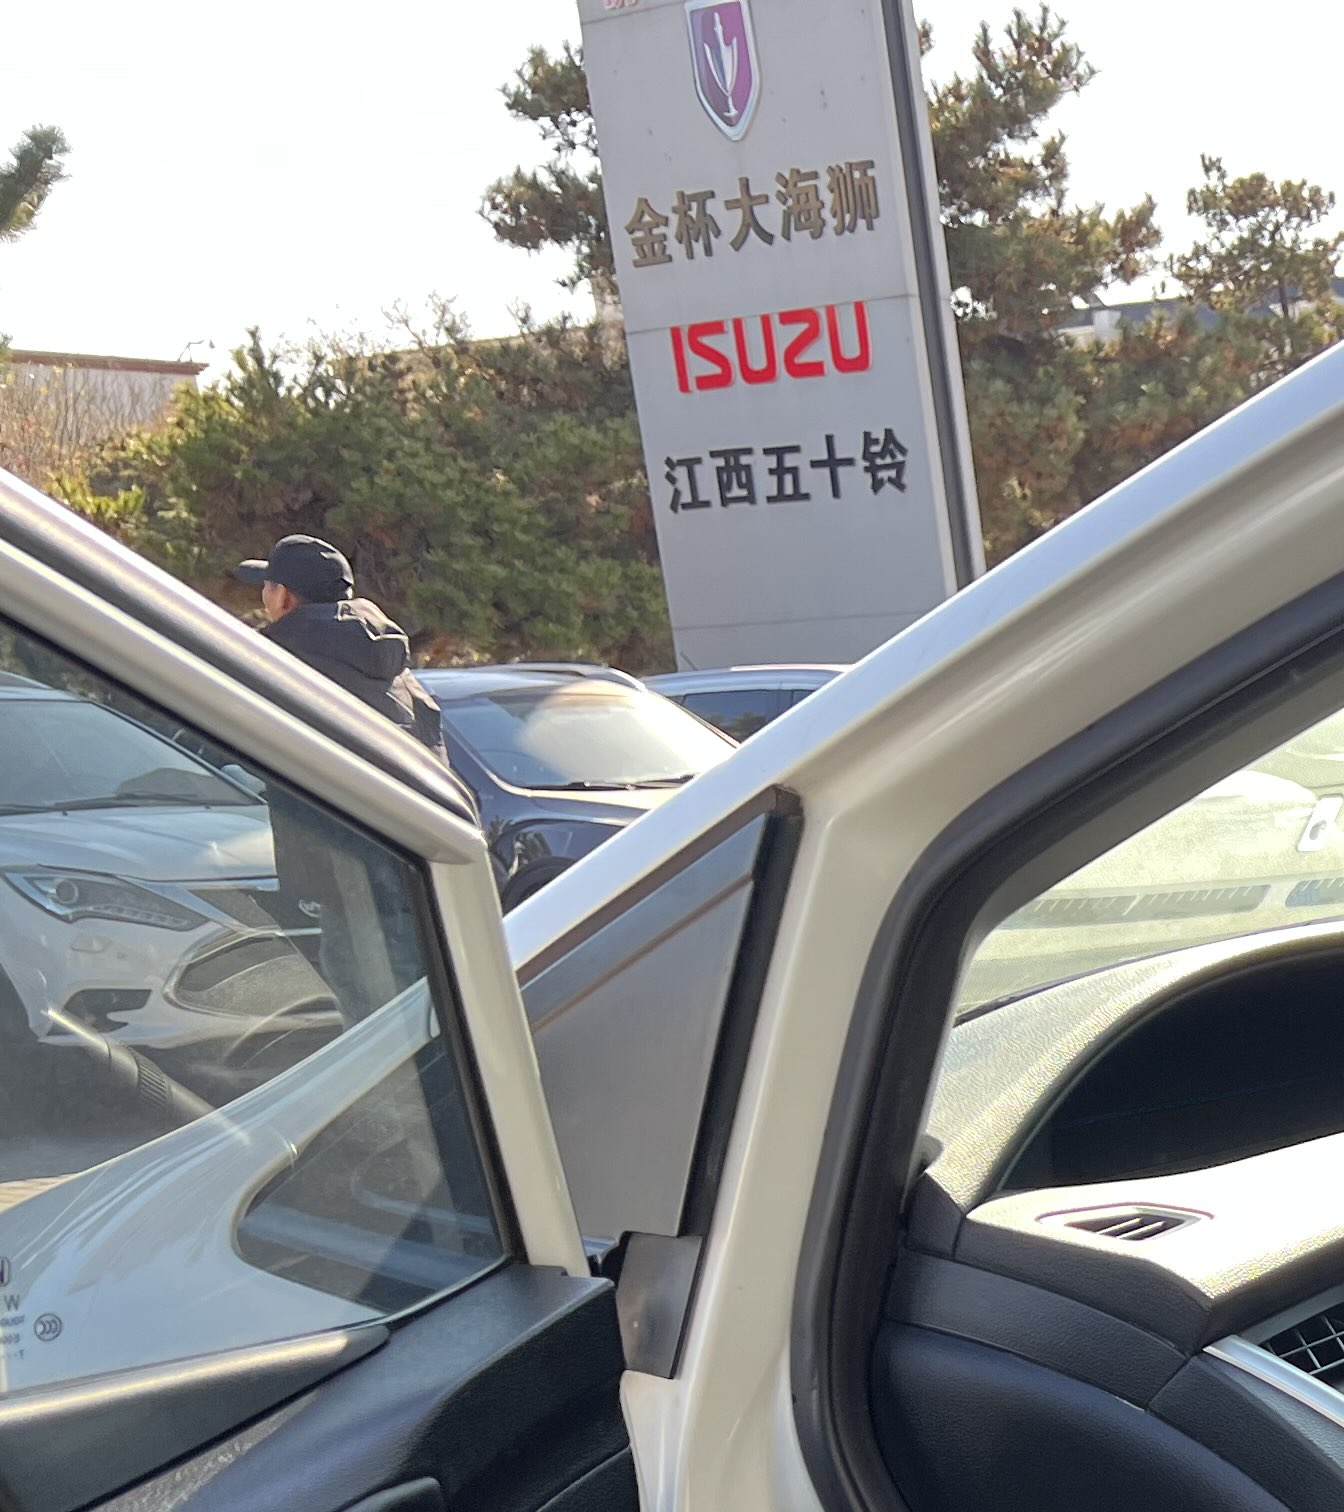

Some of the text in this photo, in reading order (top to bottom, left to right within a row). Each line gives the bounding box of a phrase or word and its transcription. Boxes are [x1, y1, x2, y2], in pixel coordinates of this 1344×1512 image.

[624, 159, 881, 269] 金杯大海狮
[669, 300, 873, 394] ISUZU
[663, 427, 909, 514] 江西五十铃
